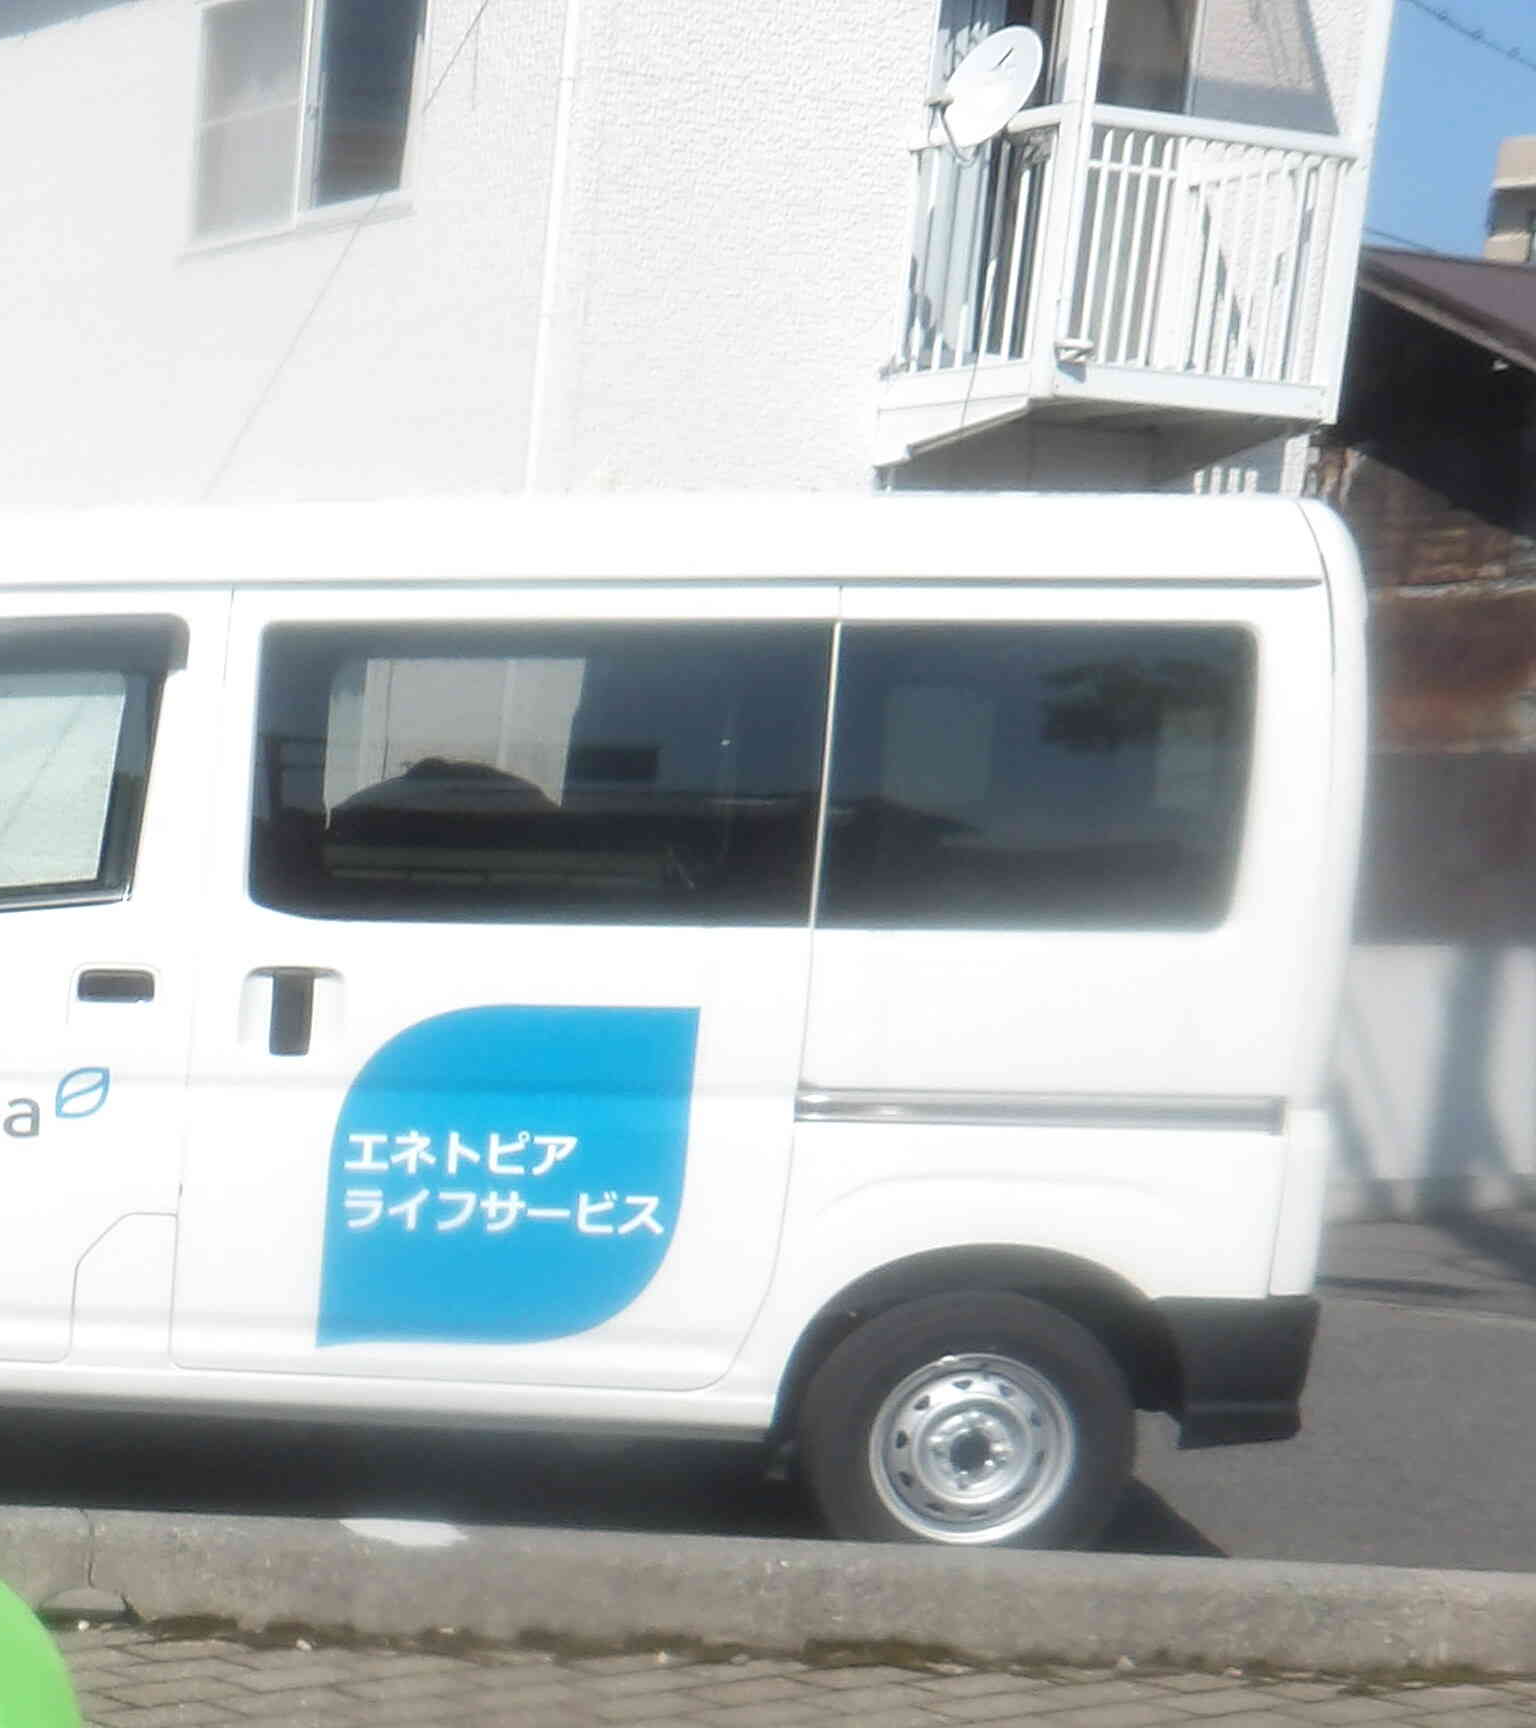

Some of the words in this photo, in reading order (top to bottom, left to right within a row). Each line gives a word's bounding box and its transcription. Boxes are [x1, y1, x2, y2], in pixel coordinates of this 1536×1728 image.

[344, 1129, 578, 1176] エネトピア
[344, 1188, 664, 1235] ライフサービス
